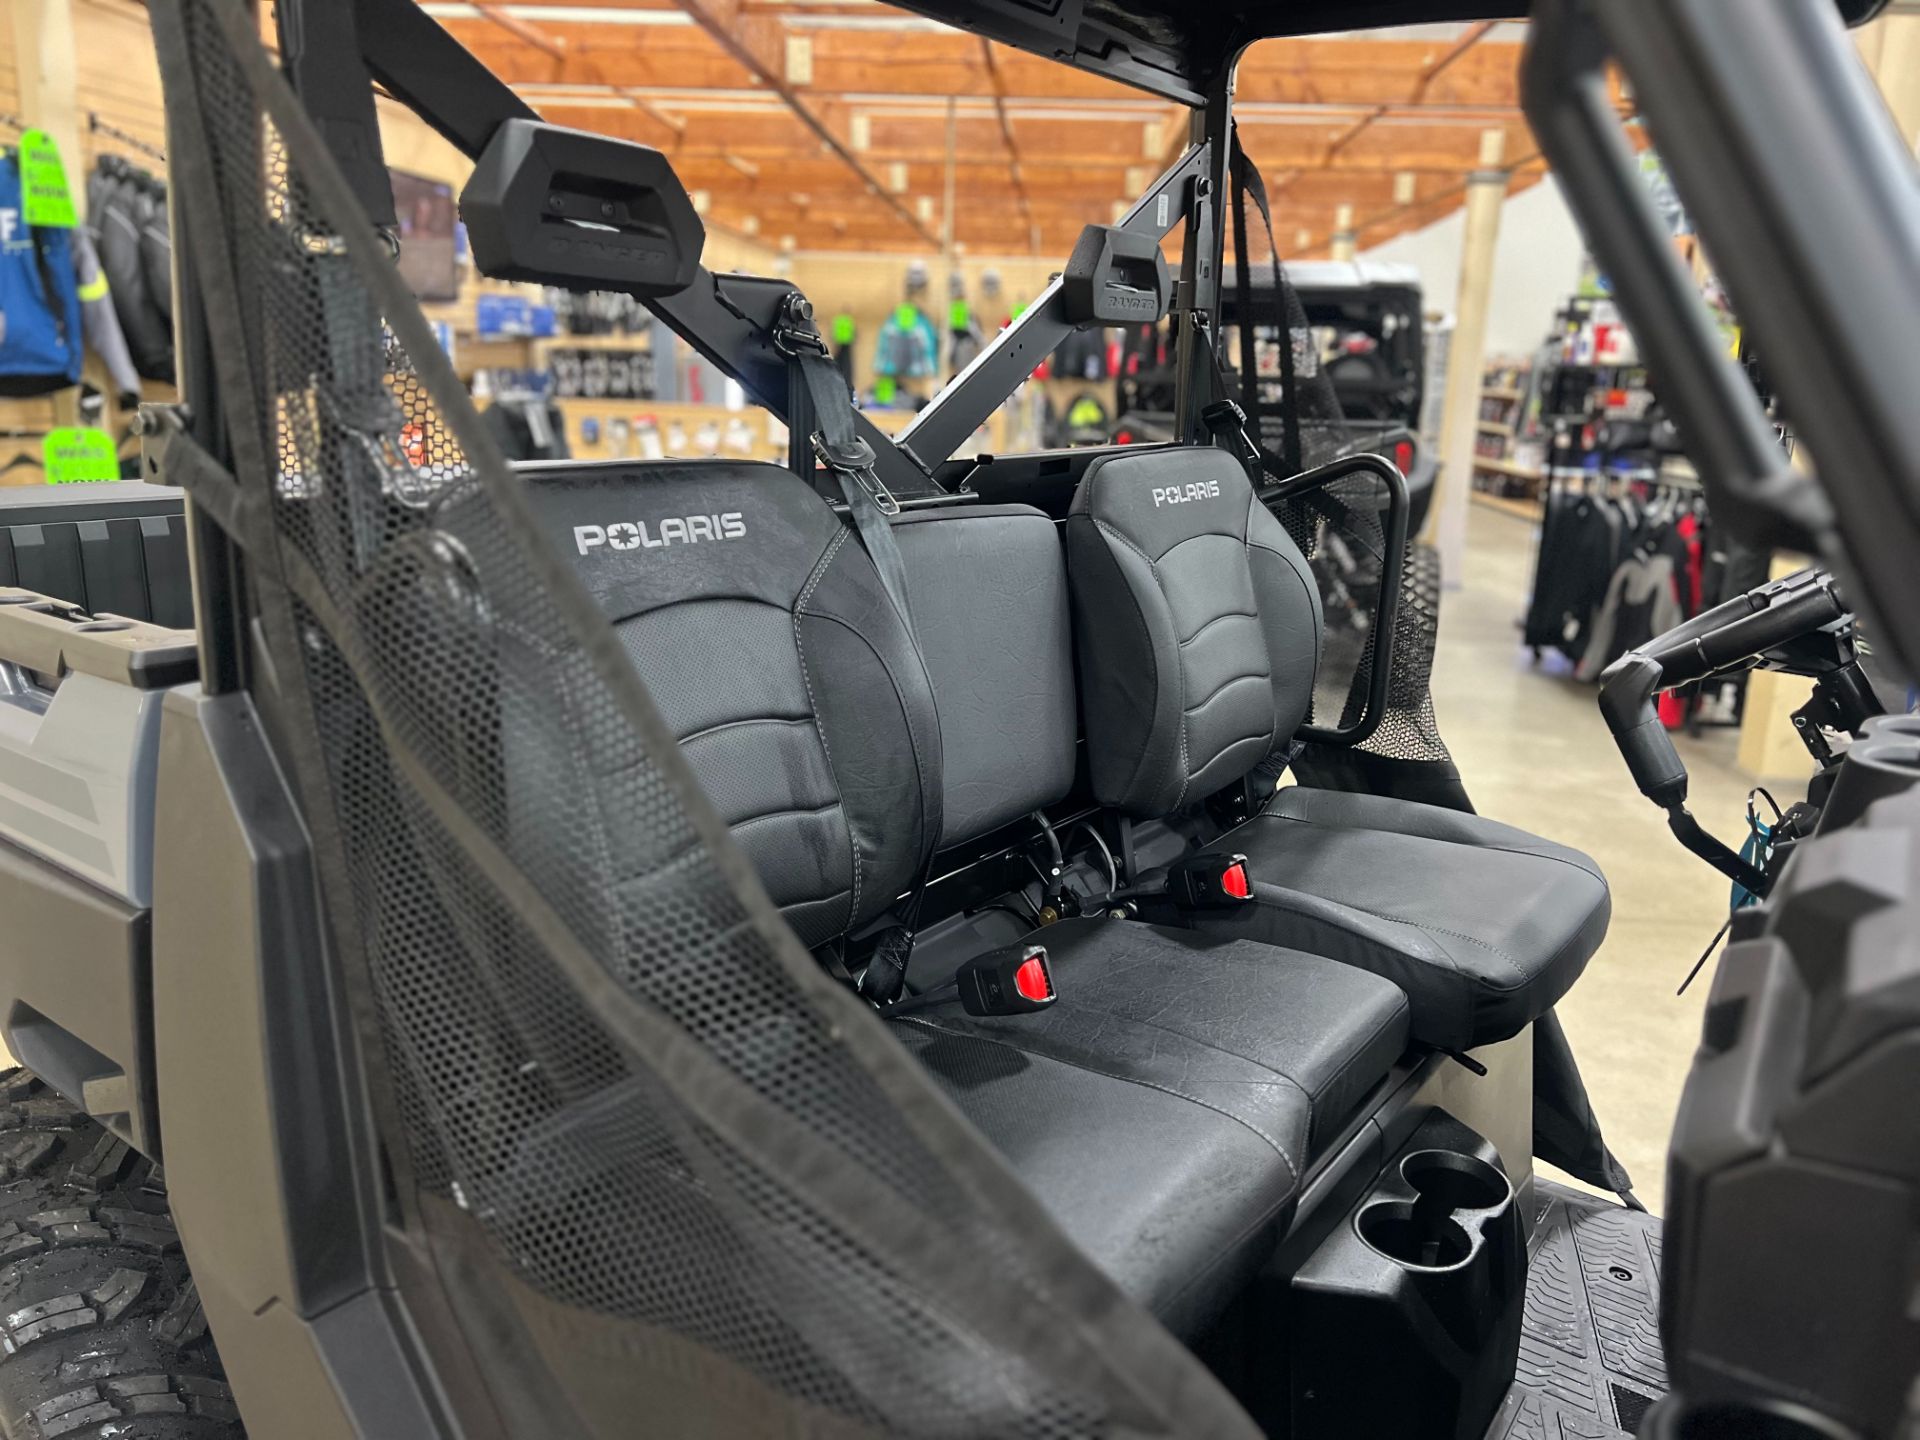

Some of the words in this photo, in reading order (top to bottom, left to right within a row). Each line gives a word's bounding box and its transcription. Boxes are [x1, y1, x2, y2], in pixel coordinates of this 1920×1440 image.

[1107, 295, 1155, 311] RANGER
[1152, 480, 1220, 508] POLARIS
[573, 502, 747, 556] POLARIS
